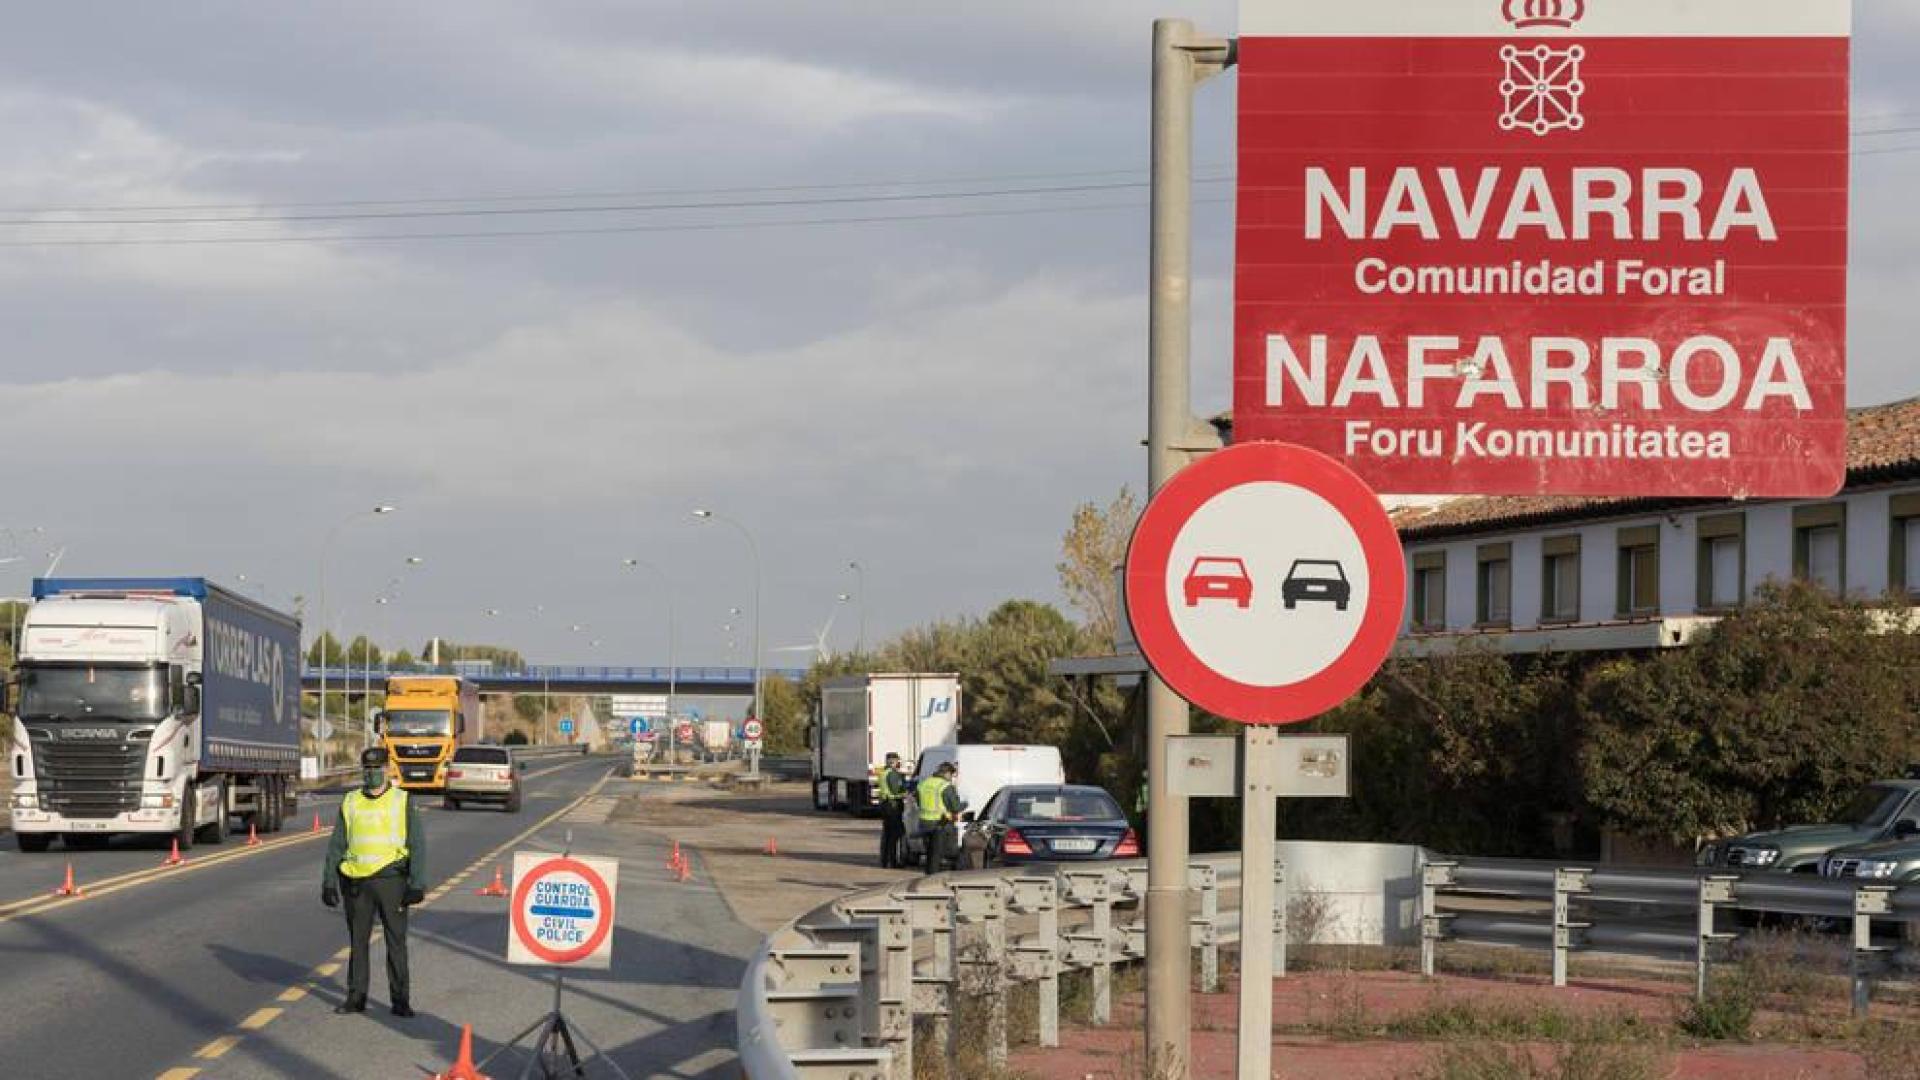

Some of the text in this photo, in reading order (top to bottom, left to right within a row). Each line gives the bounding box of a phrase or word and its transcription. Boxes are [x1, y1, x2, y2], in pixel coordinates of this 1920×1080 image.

[1304, 166, 1778, 241] NAVARRA
[1354, 257, 1725, 295] Comunidad Foral
[1265, 334, 1814, 412] NAFARROA
[1345, 420, 1731, 460] Foru Komunitatea
[535, 894, 590, 907] GUARDIA
[536, 881, 592, 896] CONTROL
[537, 928, 584, 943] POLICE
[544, 916, 575, 930] CIVIL
